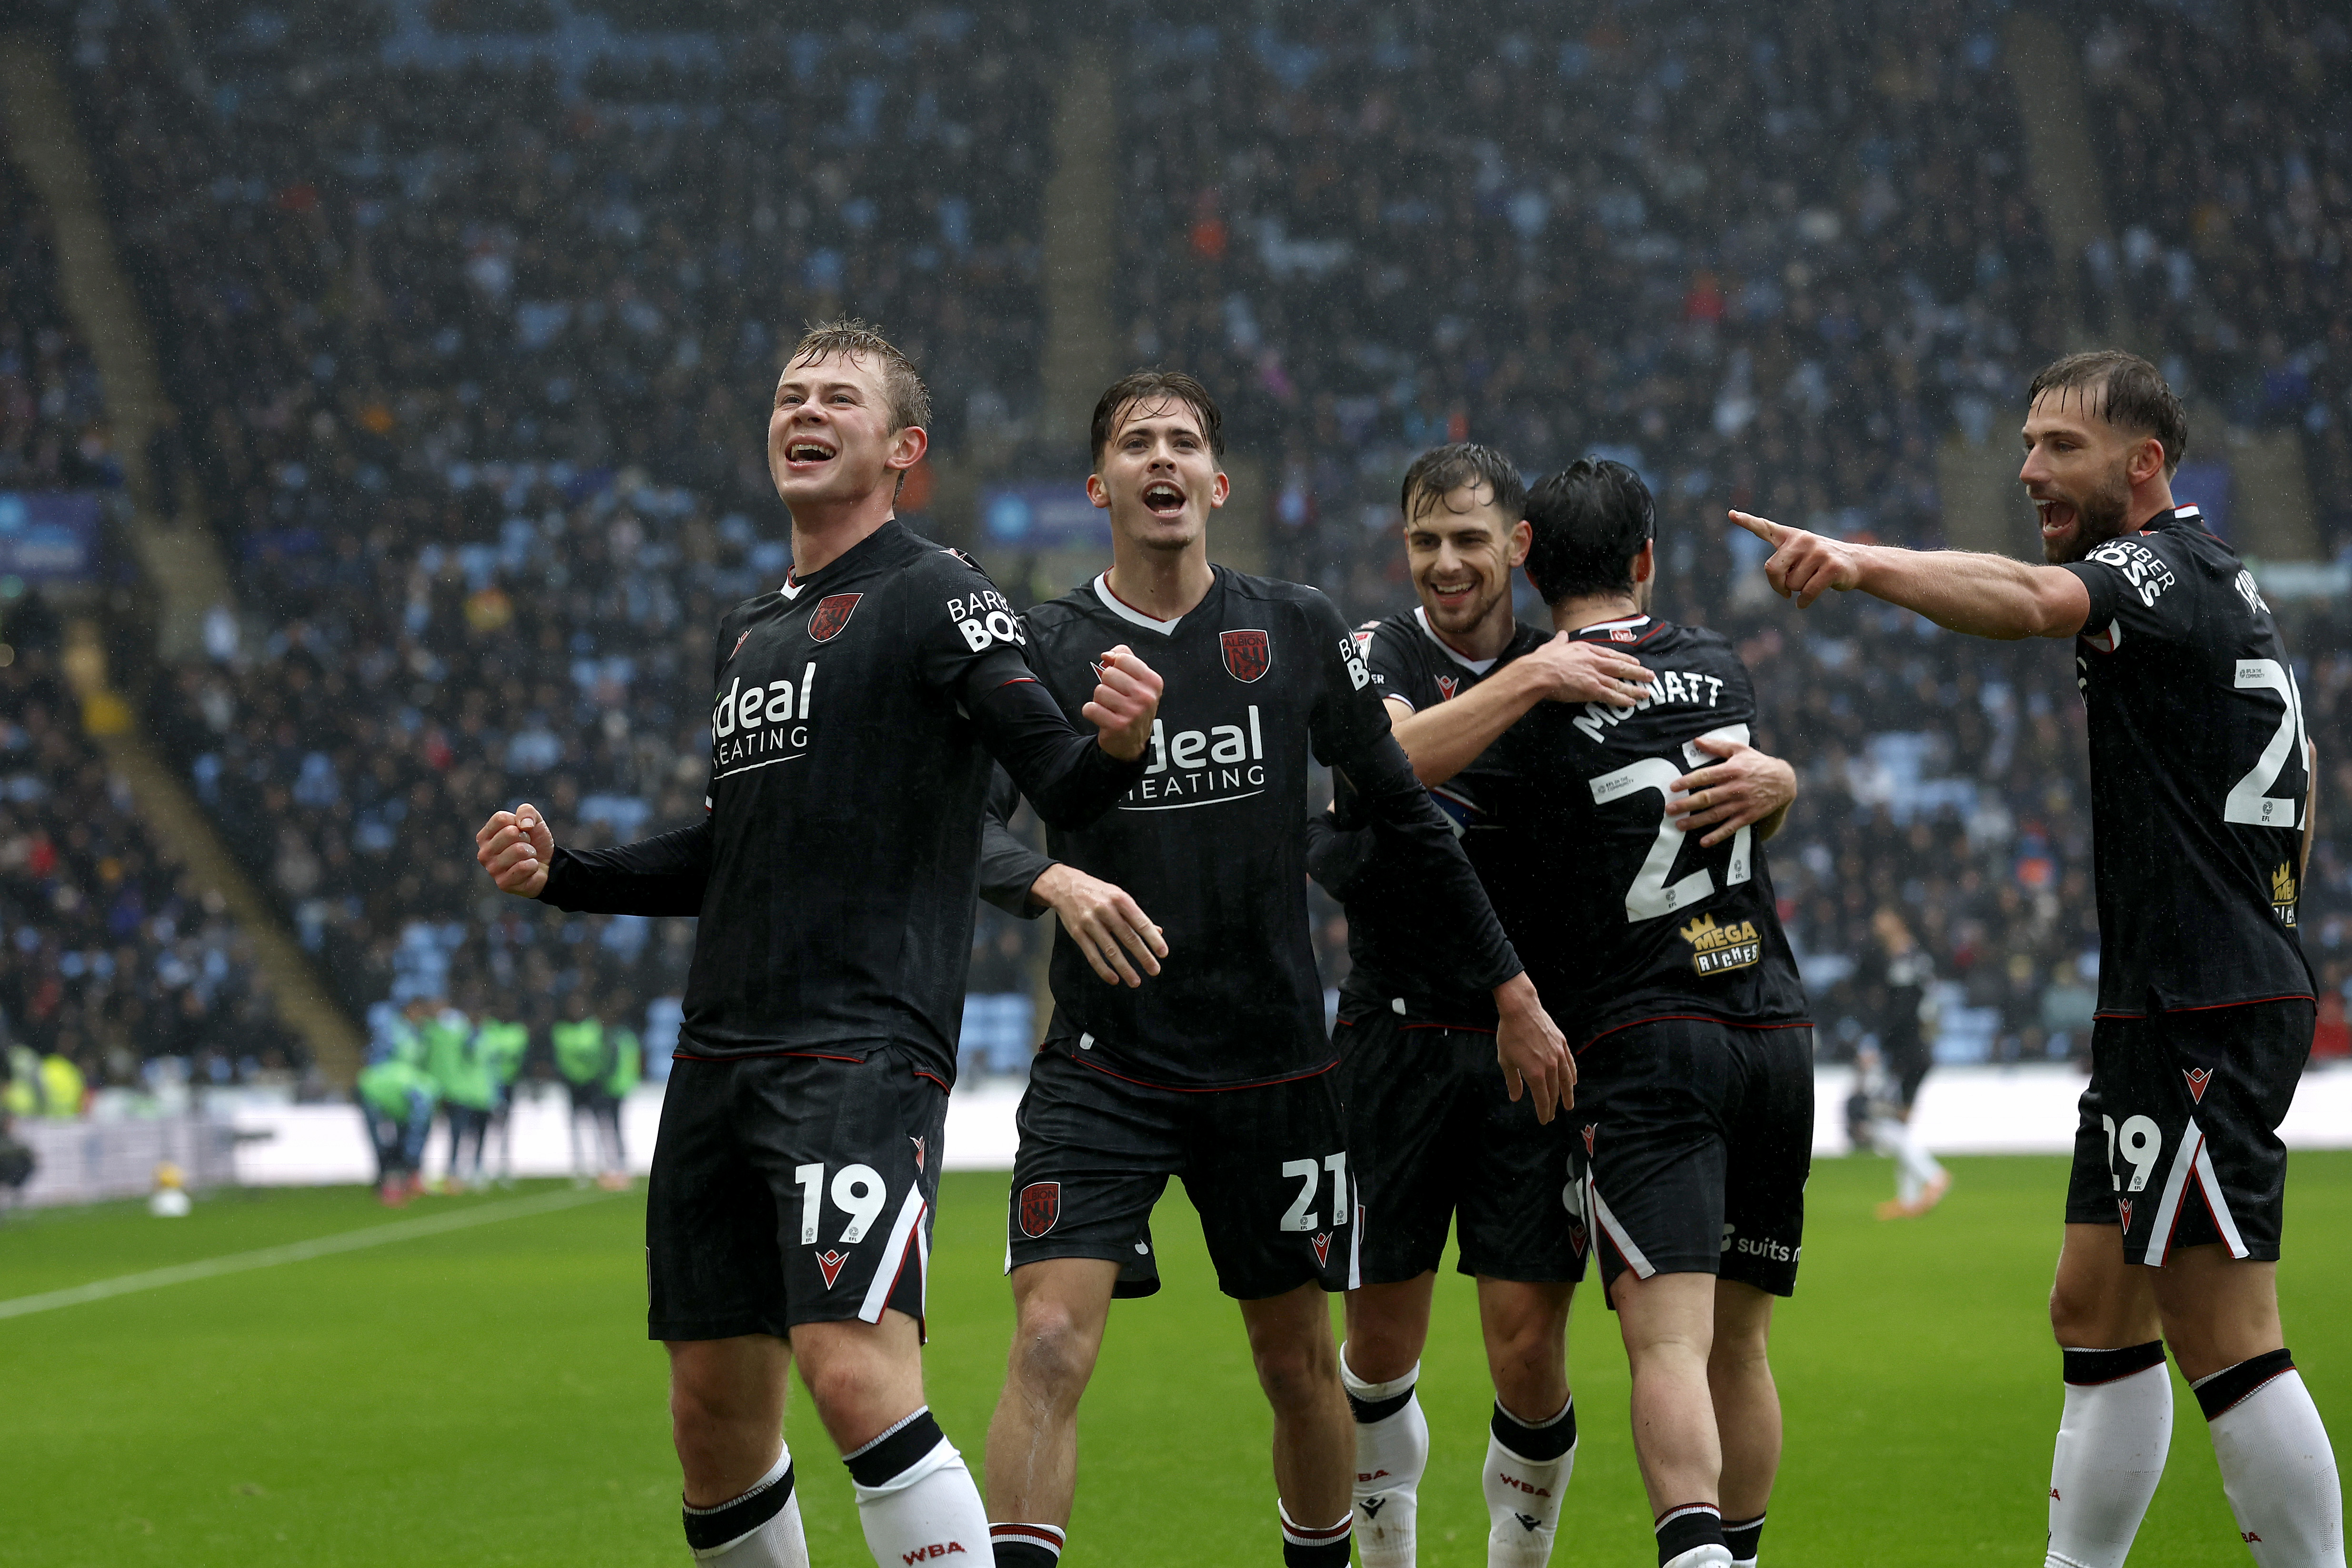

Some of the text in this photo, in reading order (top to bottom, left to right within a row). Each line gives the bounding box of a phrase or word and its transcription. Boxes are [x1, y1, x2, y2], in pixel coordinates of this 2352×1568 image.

[1224, 637, 1265, 647] ALBION
[1371, 673, 1385, 685] ER
[1144, 705, 1263, 775] deal
[1694, 920, 1758, 951] MEGA
[1698, 943, 1758, 972] RICHES
[1280, 1150, 1348, 1231] 21
[795, 1162, 887, 1246] 19
[1738, 1238, 1790, 1262] suits
[1358, 1469, 1391, 1482] BA
[1500, 1473, 1551, 1498] WBA
[2240, 1531, 2262, 1543] BA
[902, 1541, 967, 1567] WBA
